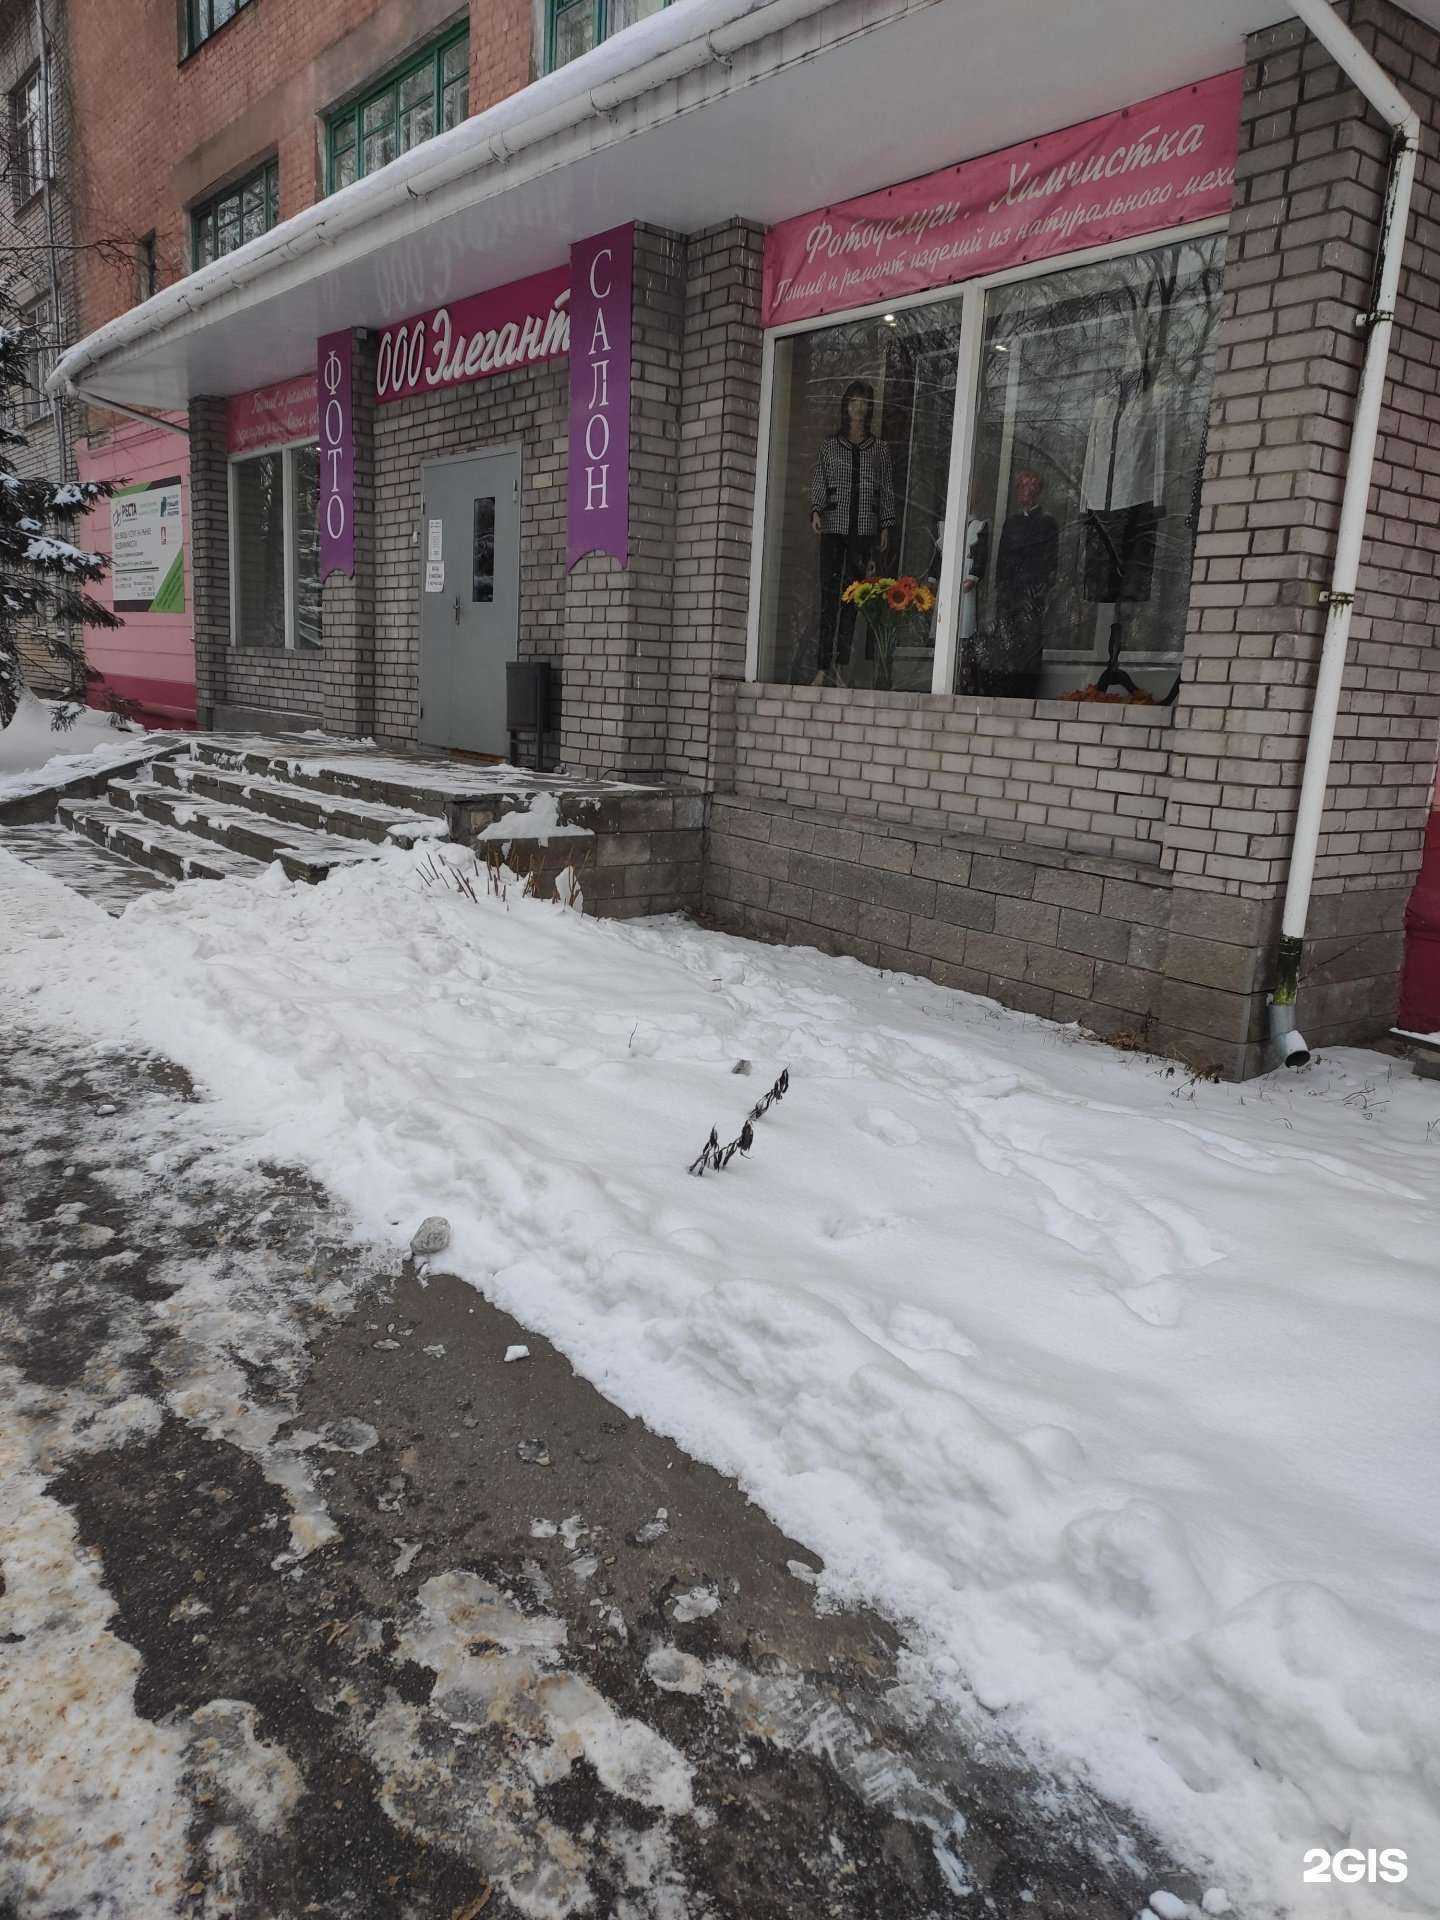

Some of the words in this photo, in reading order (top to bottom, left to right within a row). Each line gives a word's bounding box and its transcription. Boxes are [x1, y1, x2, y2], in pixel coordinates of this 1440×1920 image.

[988, 124, 1205, 213] Химчистка
[772, 271, 824, 306] Пошив
[827, 278, 838, 291] и
[838, 254, 905, 296] ремонт
[910, 227, 985, 272] изделий
[988, 227, 1010, 249] из
[1015, 184, 1172, 242] натурального
[376, 320, 425, 396] ООО
[425, 288, 571, 385] Элегант
[584, 249, 613, 511] САЛОН
[324, 350, 345, 540] ФОТО
